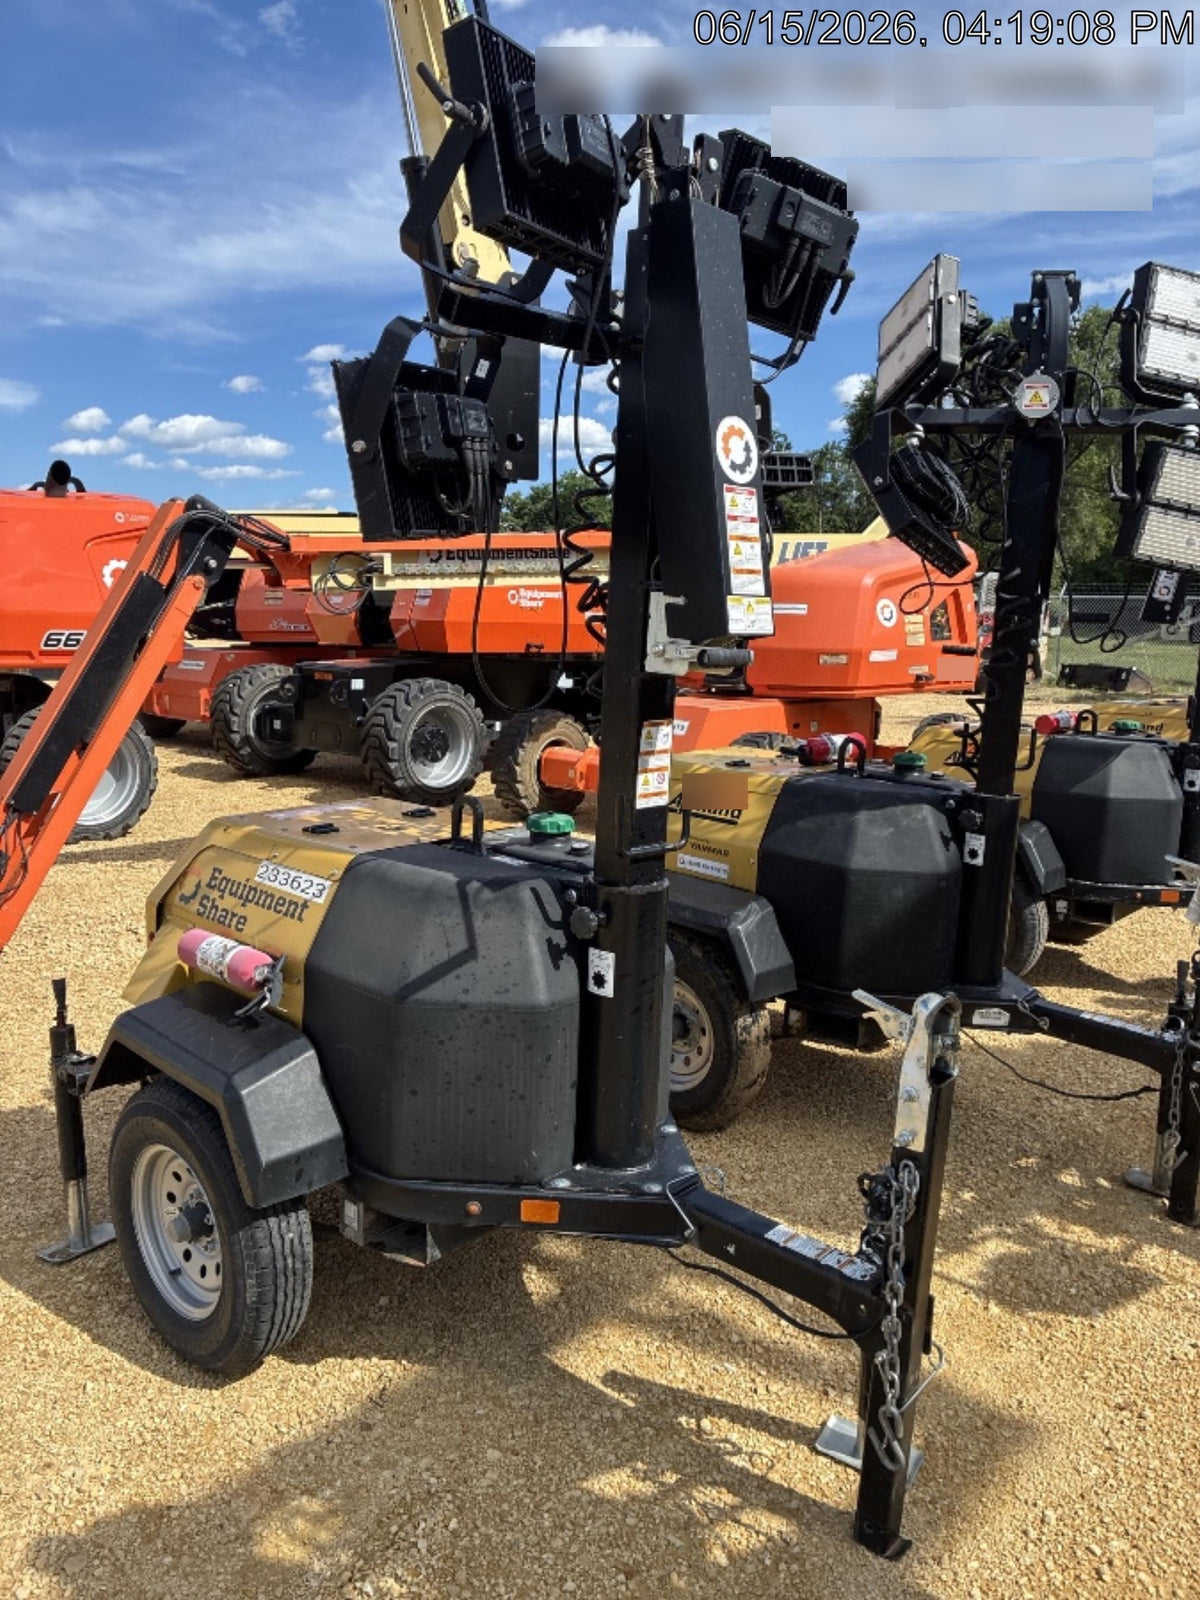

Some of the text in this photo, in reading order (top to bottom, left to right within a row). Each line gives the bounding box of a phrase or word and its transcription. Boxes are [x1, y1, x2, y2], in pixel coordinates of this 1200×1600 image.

[446, 549, 569, 562] EquimentShae
[777, 542, 828, 565] LIFT
[206, 867, 309, 922] Equipment
[256, 864, 327, 899] 233623
[197, 893, 247, 932] Share
